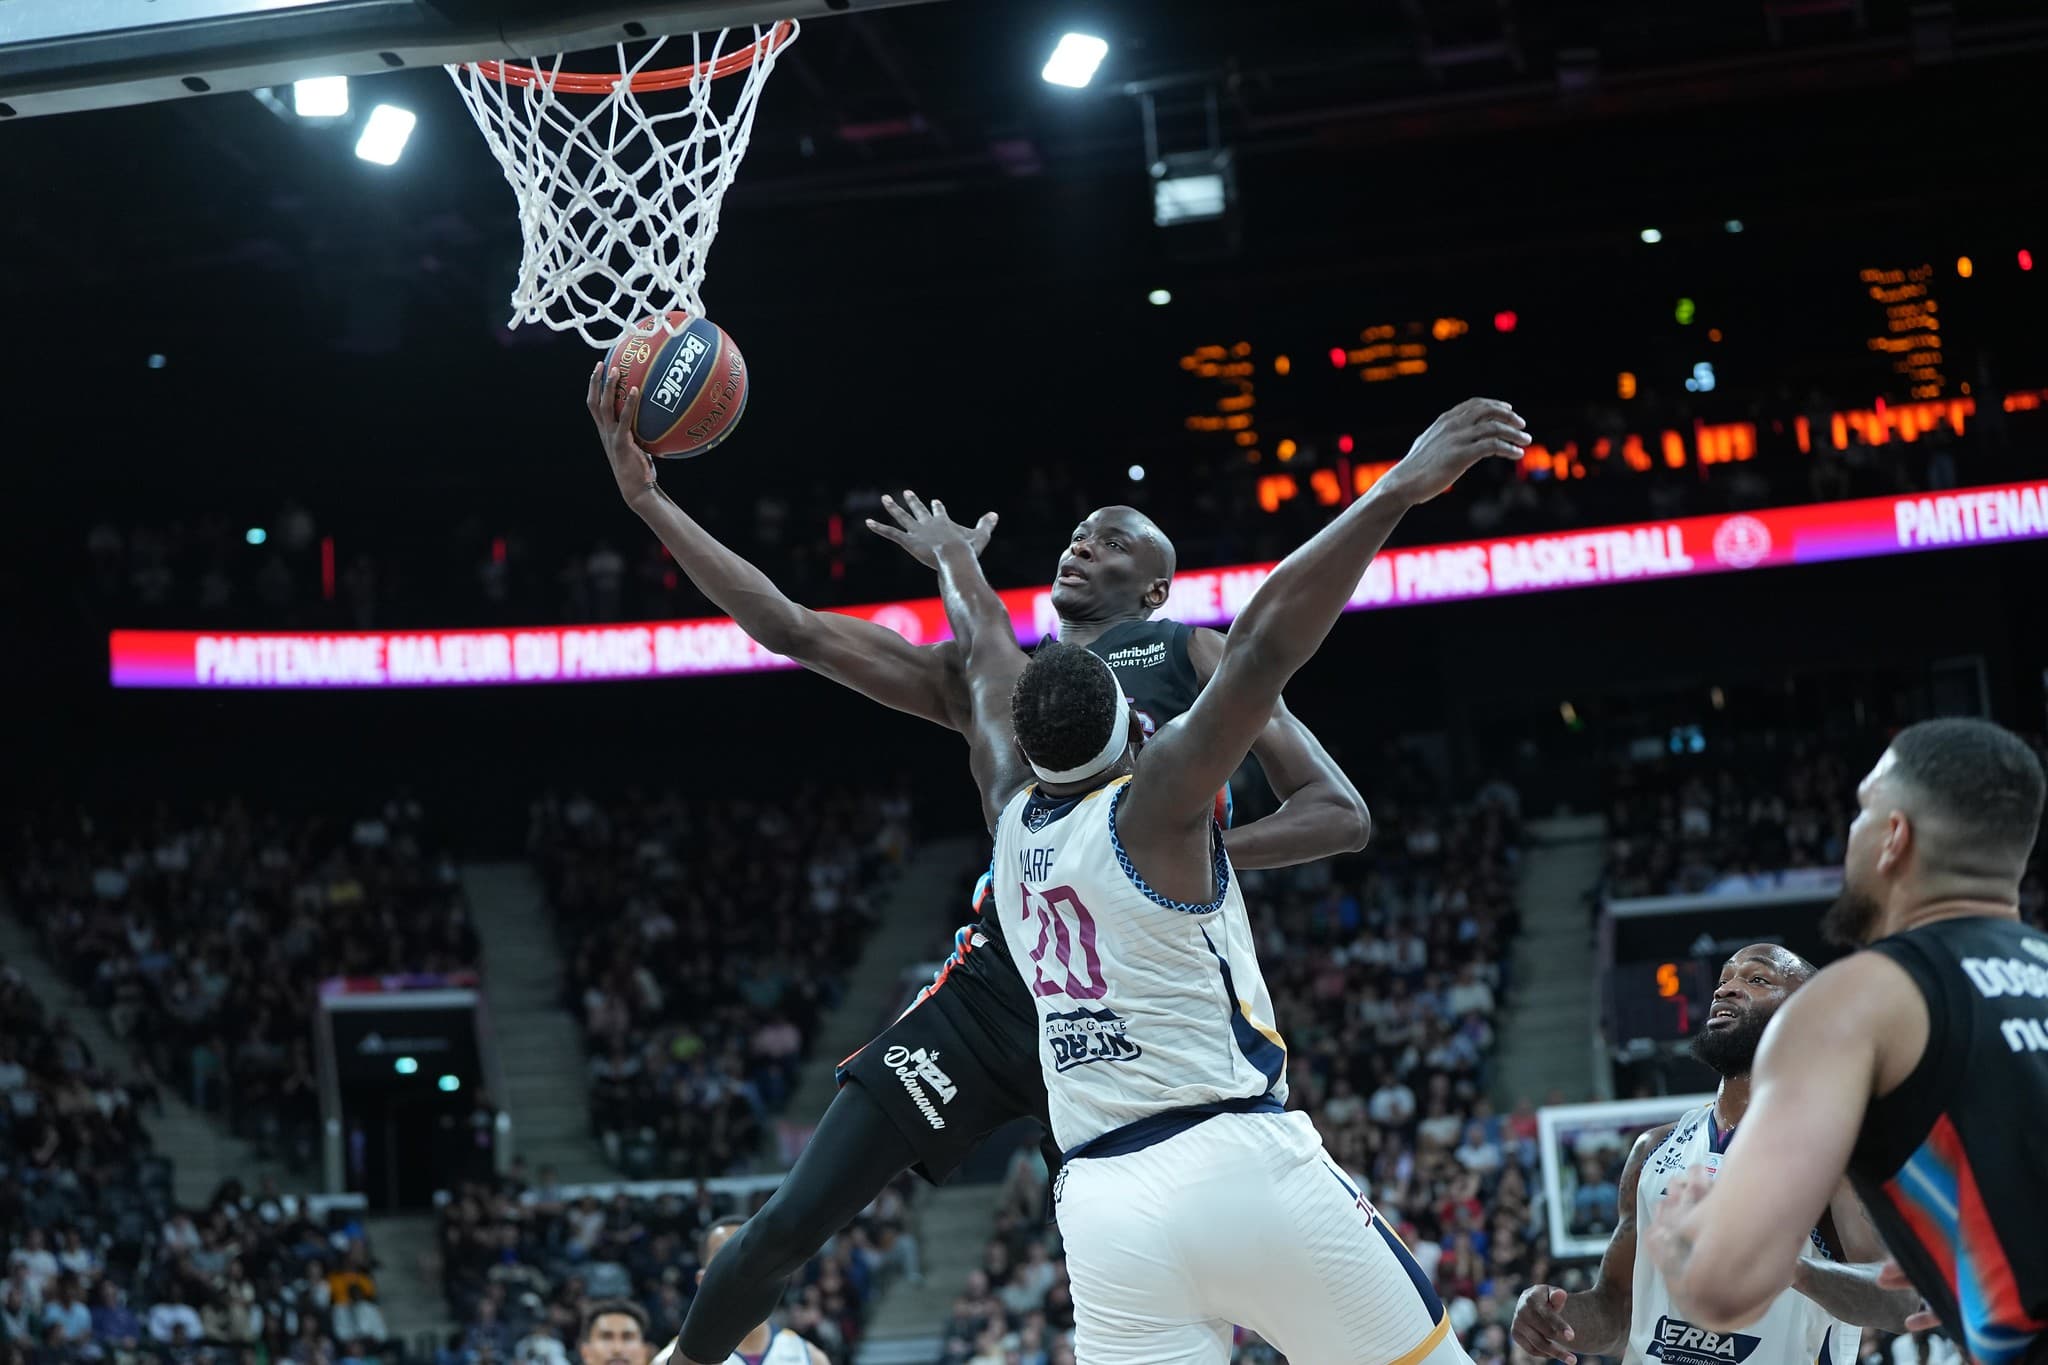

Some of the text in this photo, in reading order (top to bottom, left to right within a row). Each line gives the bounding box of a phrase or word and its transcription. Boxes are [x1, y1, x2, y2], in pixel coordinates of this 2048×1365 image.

[656, 335, 706, 405] Betclic
[1395, 547, 1489, 601] PARIS
[1489, 525, 1694, 590] BASKETBALL
[196, 636, 384, 684] PARTENAIRE
[388, 633, 510, 682] MAJEUR
[514, 632, 559, 680] DU
[561, 628, 653, 678] PARIS
[1107, 651, 1167, 668] COURTYARD
[1109, 643, 1166, 661] nutribullet
[1021, 882, 1107, 1000] 20
[884, 1045, 946, 1130] Delamama
[910, 1048, 958, 1105] PIZZA
